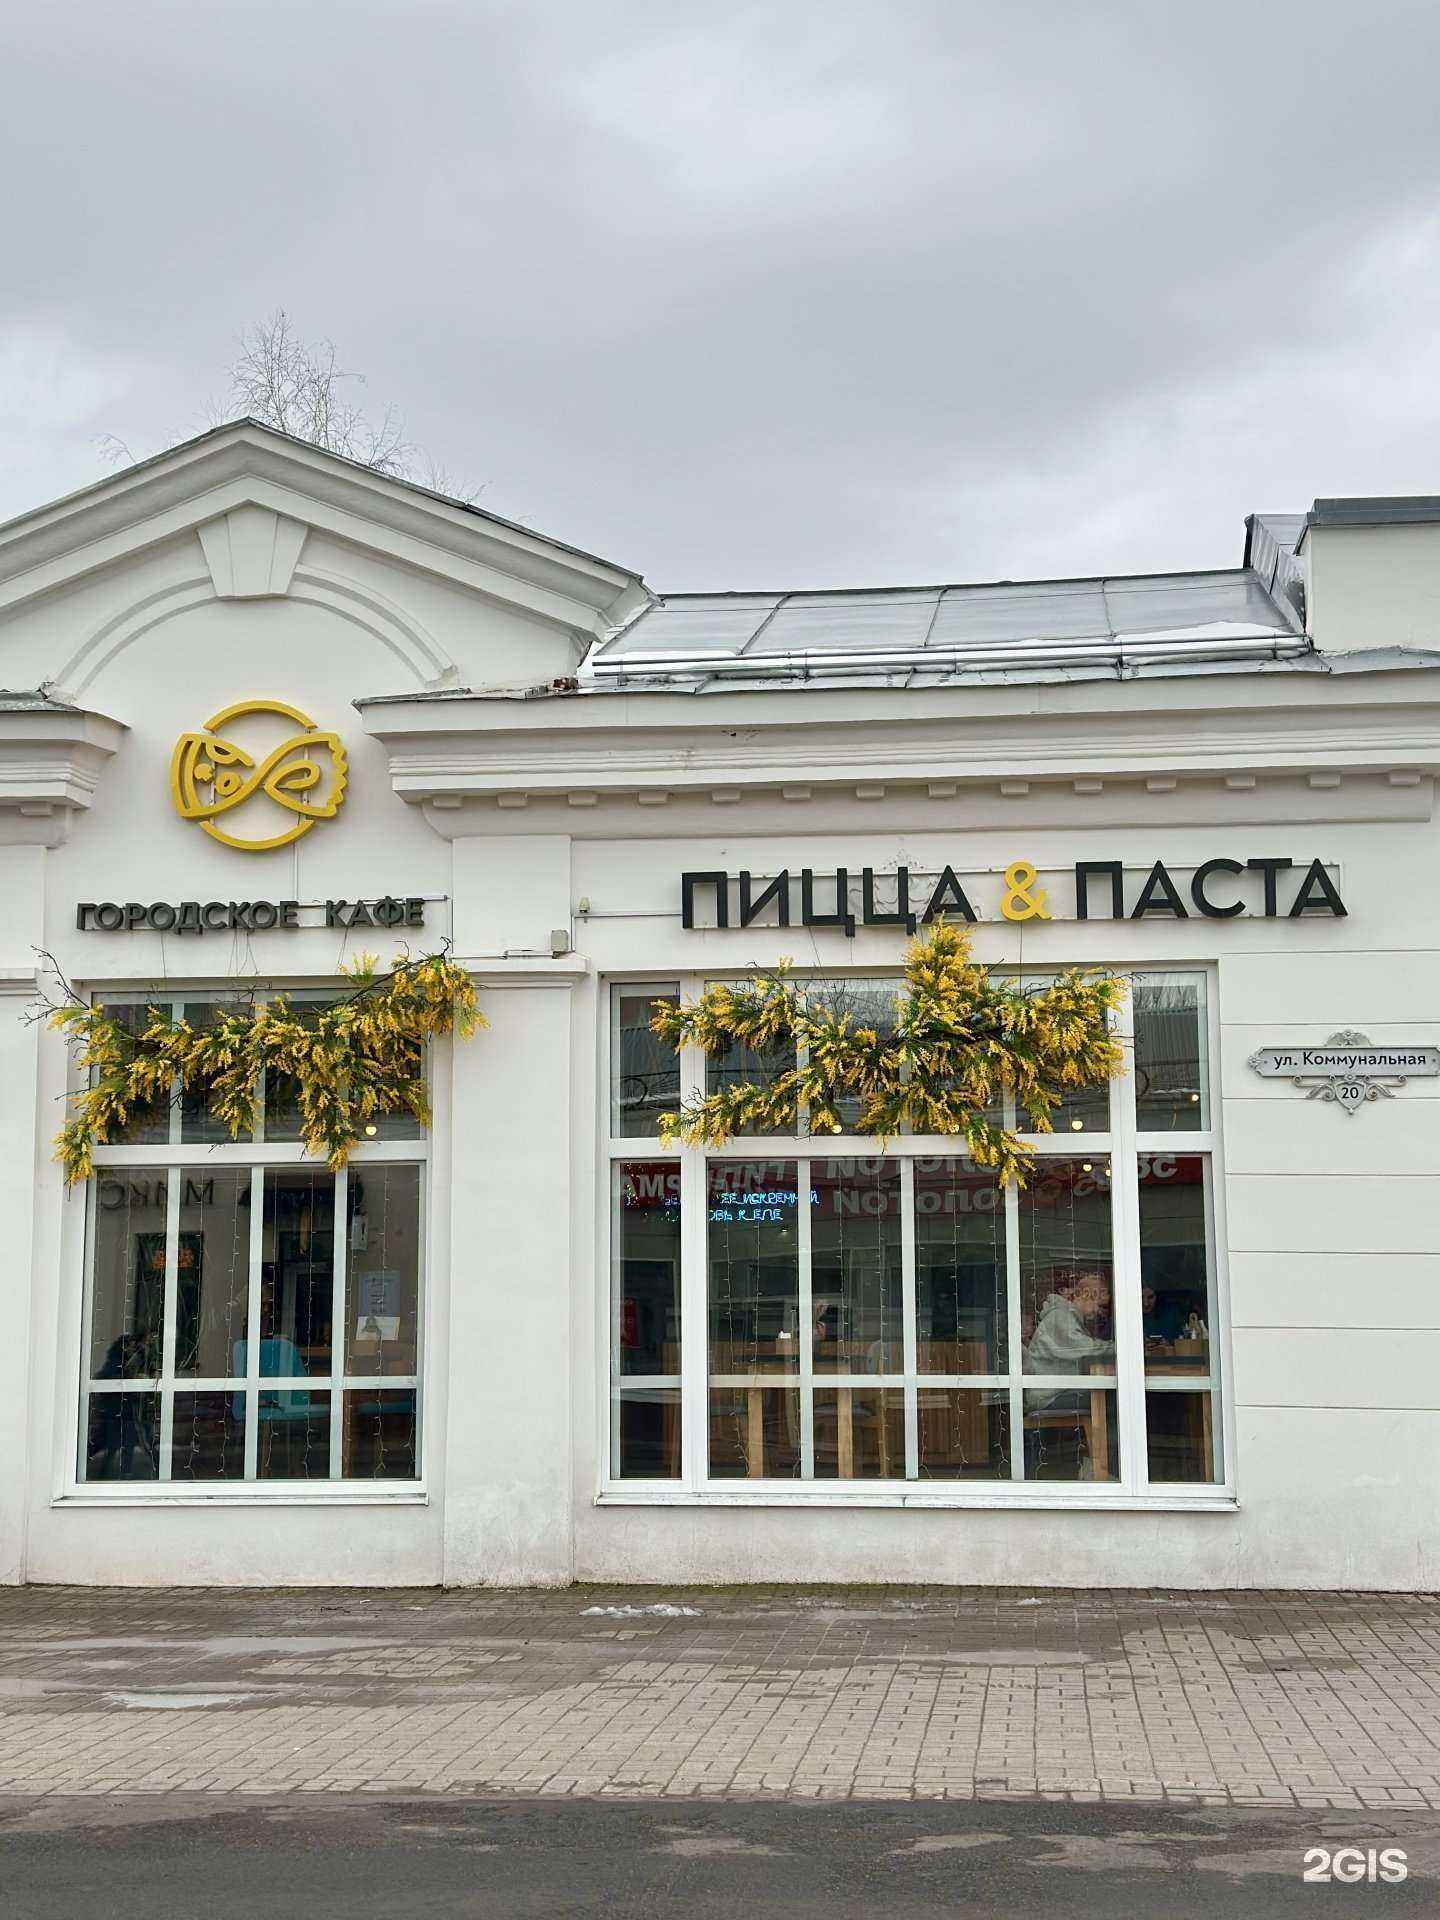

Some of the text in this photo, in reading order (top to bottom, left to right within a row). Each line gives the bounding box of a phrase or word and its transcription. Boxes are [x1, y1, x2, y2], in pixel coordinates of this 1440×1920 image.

[681, 858, 1348, 937] ПИЦЦА & ПАСТА
[76, 896, 425, 935] ГОРОДСКОЕ КАФЕ
[1273, 1051, 1427, 1070] ул. Коммунальная
[1341, 1087, 1359, 1099] 20
